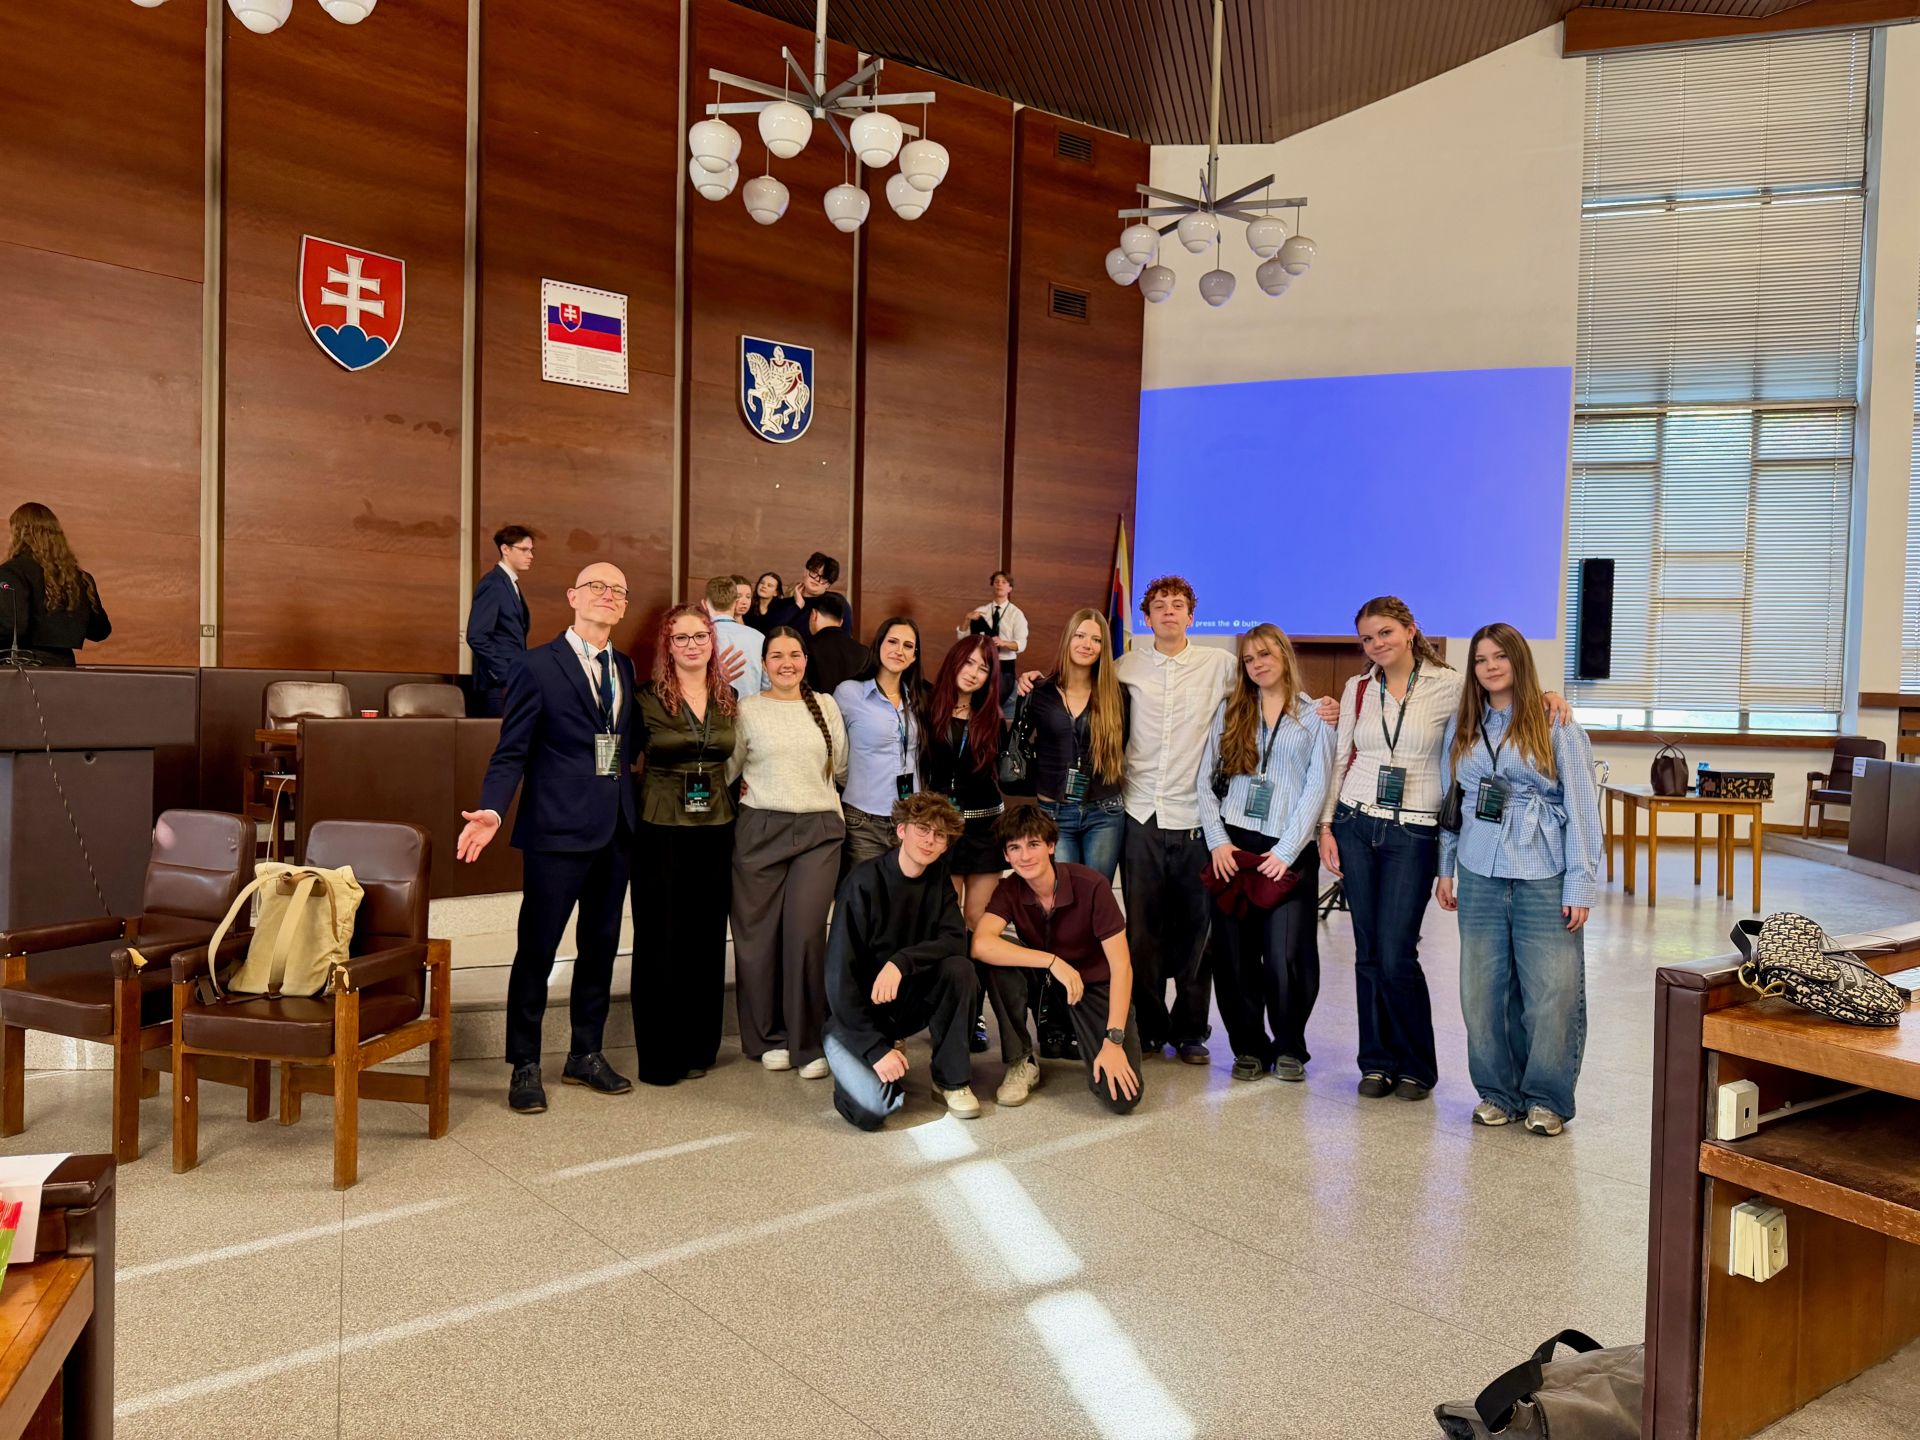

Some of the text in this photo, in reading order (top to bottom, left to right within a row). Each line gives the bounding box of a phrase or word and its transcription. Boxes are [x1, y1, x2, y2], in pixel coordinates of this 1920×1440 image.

[1195, 620, 1216, 628] press
[1218, 619, 1230, 627] the
[1241, 619, 1261, 627] butt
